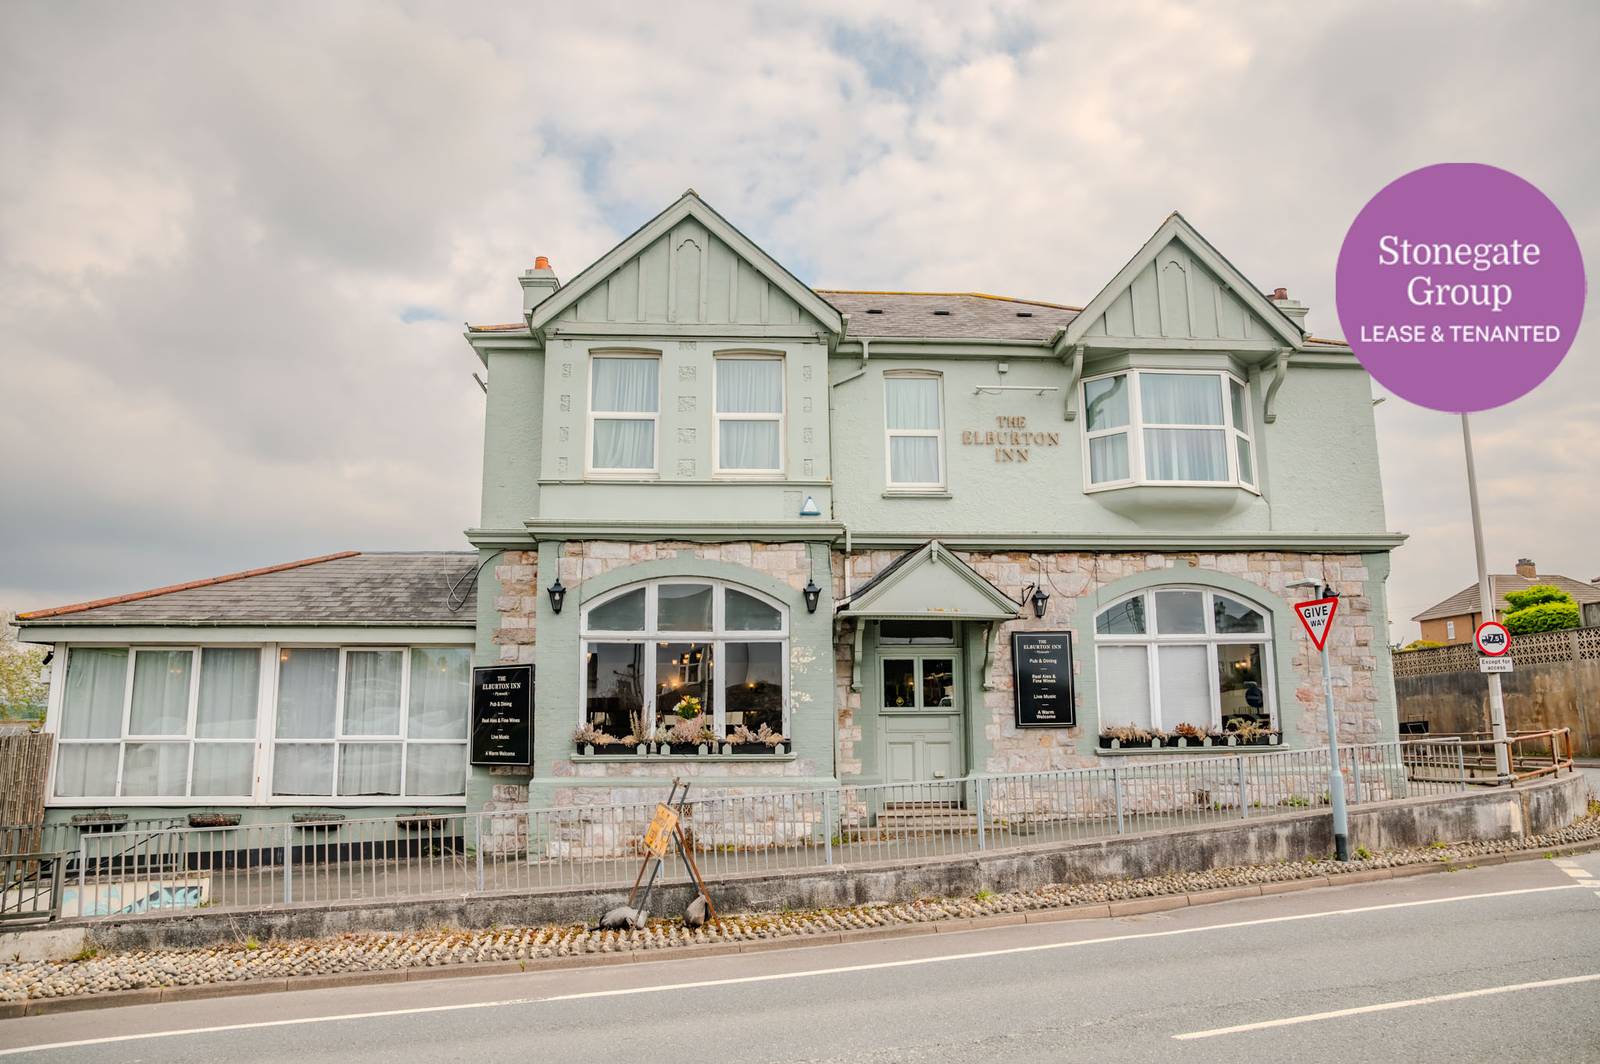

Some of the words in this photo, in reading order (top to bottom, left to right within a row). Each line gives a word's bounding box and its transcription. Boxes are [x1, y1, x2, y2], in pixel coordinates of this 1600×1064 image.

[996, 416, 1026, 428] THE
[962, 431, 1061, 447] ELBURTON
[995, 448, 1029, 464] INN
[1304, 605, 1328, 618] GIVE
[1310, 619, 1325, 627] WAY
